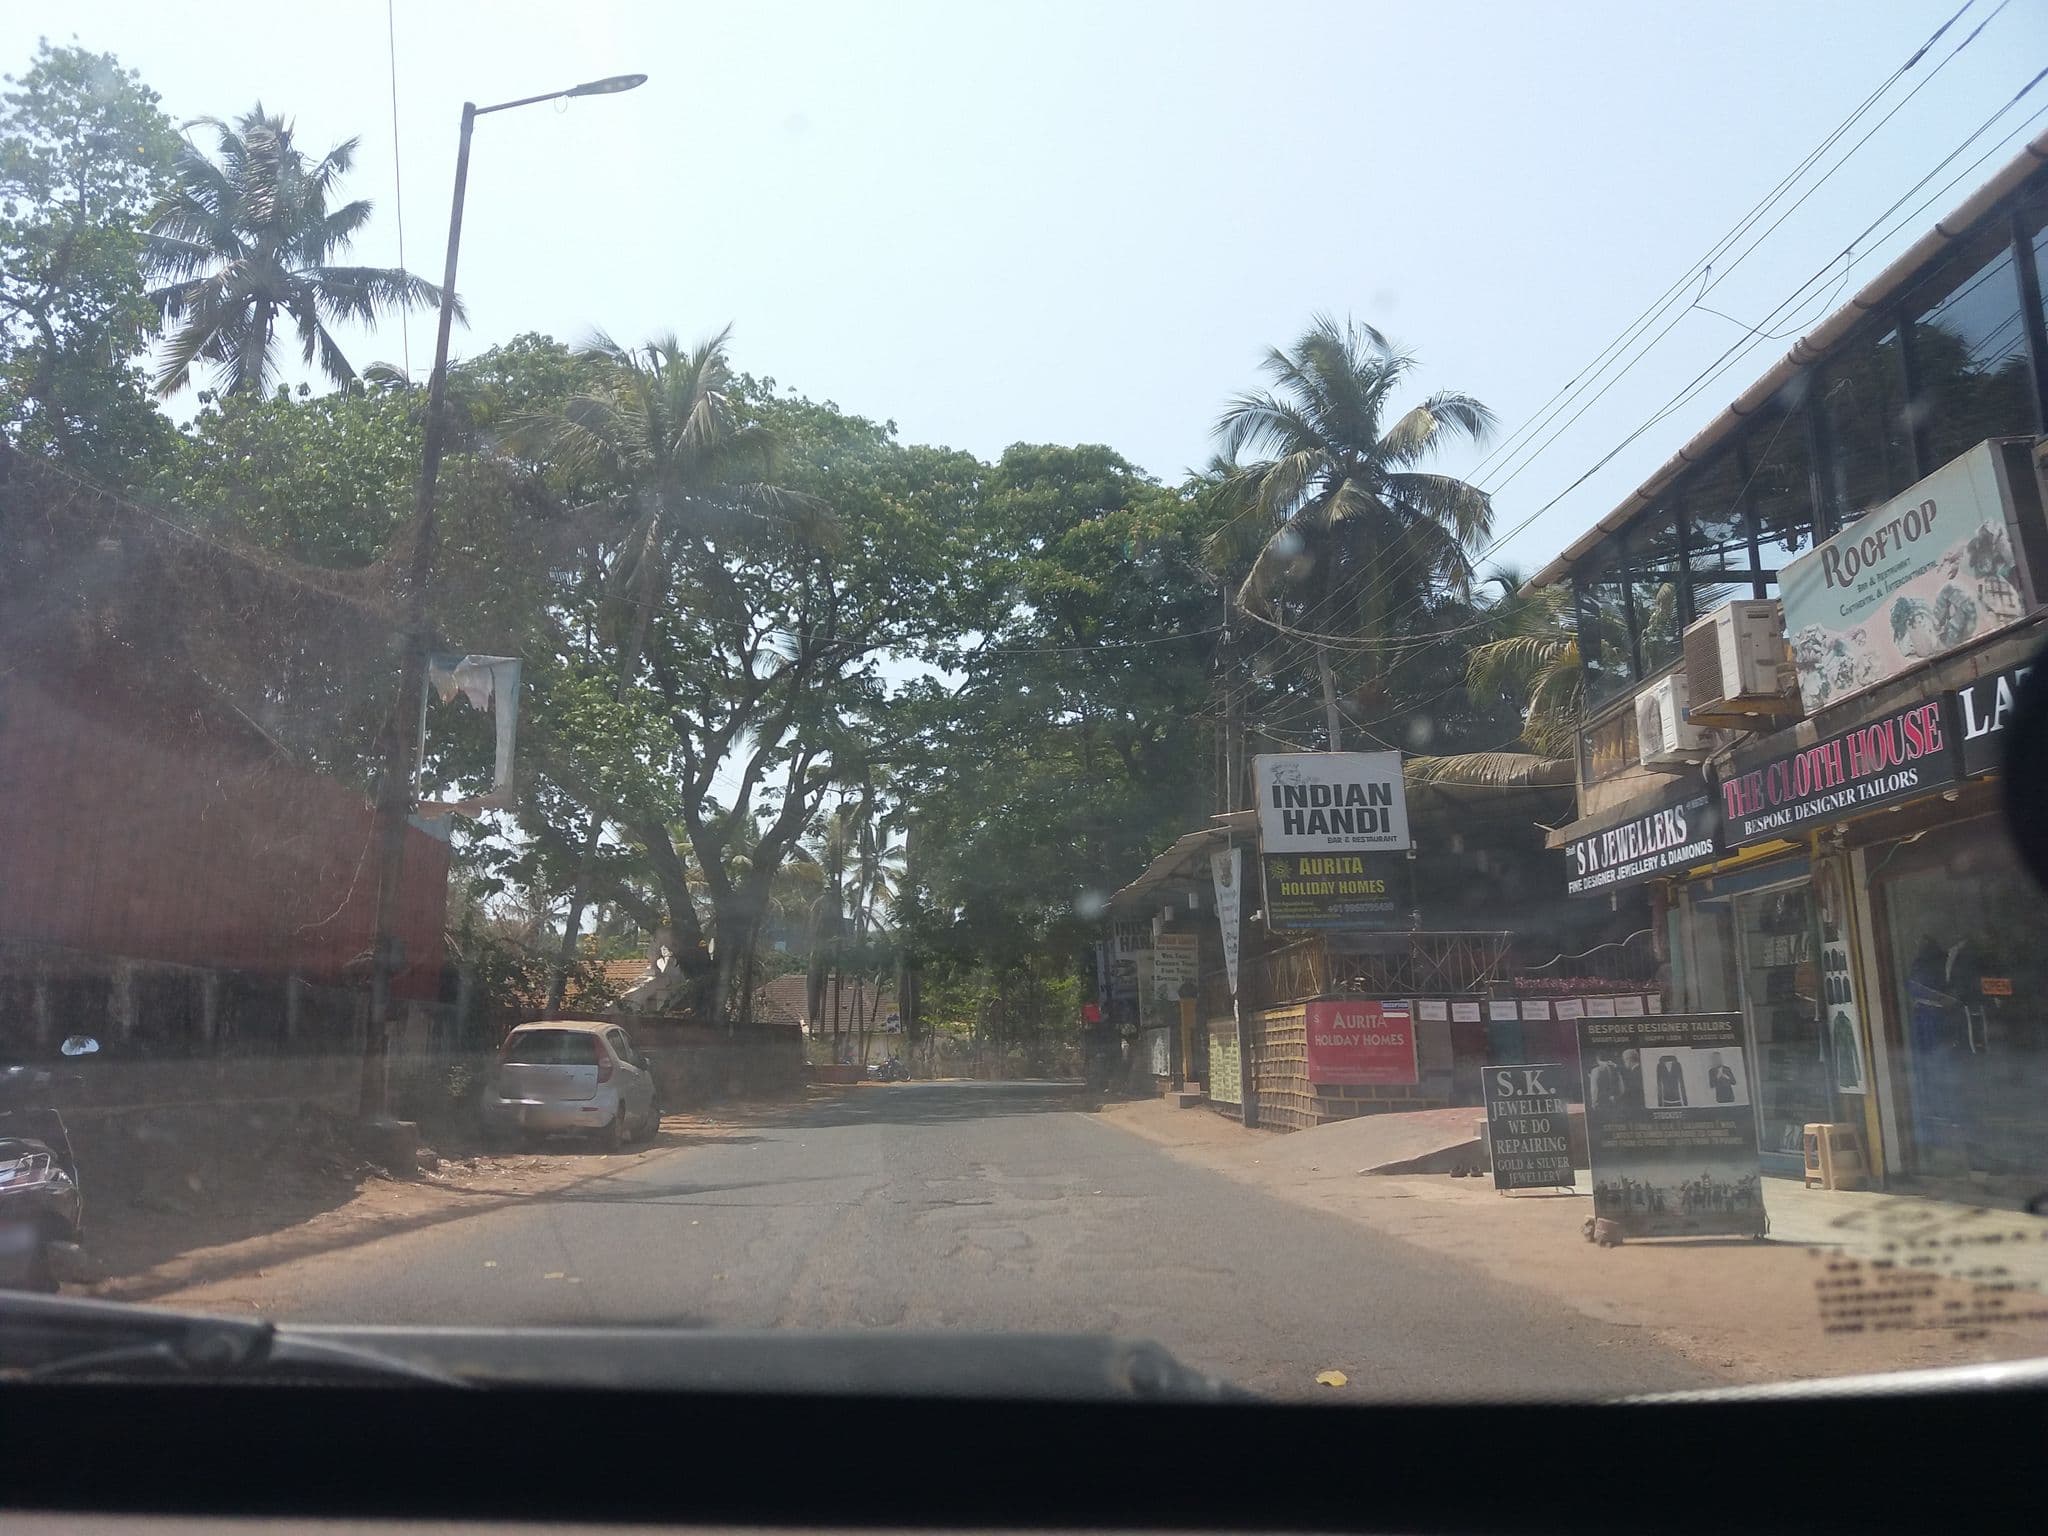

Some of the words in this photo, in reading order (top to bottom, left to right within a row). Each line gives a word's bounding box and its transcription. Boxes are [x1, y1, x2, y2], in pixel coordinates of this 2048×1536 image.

[1821, 499, 1937, 589] ROOFTOP
[1723, 770, 1765, 820] THE
[1767, 739, 1845, 806] CLOTH
[1847, 702, 1944, 785] HOUSE
[1272, 783, 1393, 808] INDIAN
[1745, 808, 1793, 836] BESPOKE
[1795, 788, 1856, 821] DESIGNER
[1857, 768, 1919, 800] TAILORS
[1283, 808, 1391, 835] HANDI
[1577, 842, 1586, 875] S
[1588, 837, 1600, 872] K
[1601, 805, 1687, 867] JEWELLERS
[1300, 857, 1364, 875] AURITA
[1568, 879, 1583, 894] FINE
[1584, 869, 1616, 890] DESIGNER
[1616, 856, 1658, 880] JEWELLERY
[1660, 855, 1668, 867] &
[1668, 838, 1714, 863] DIAMONDS
[1281, 881, 1335, 896] HOLIDAY
[1339, 880, 1385, 895] HOMES
[1333, 1012, 1388, 1029] AURITA
[1588, 1024, 1634, 1034] BESPOKE
[1637, 1022, 1689, 1033] DESIGNER
[1692, 1021, 1732, 1031] TAILORS
[1315, 1034, 1360, 1047] HOLIDAY
[1363, 1034, 1404, 1046] HOMES
[1497, 1070, 1556, 1097] S.K.
[1508, 1120, 1528, 1134] WE
[1532, 1119, 1550, 1133] DO
[1496, 1136, 1567, 1154] REPAIRING
[1497, 1159, 1524, 1171] GOLD
[1526, 1158, 1534, 1169] &
[1536, 1156, 1570, 1169] SILVER
[1508, 1171, 1561, 1187] JEWELLERY
